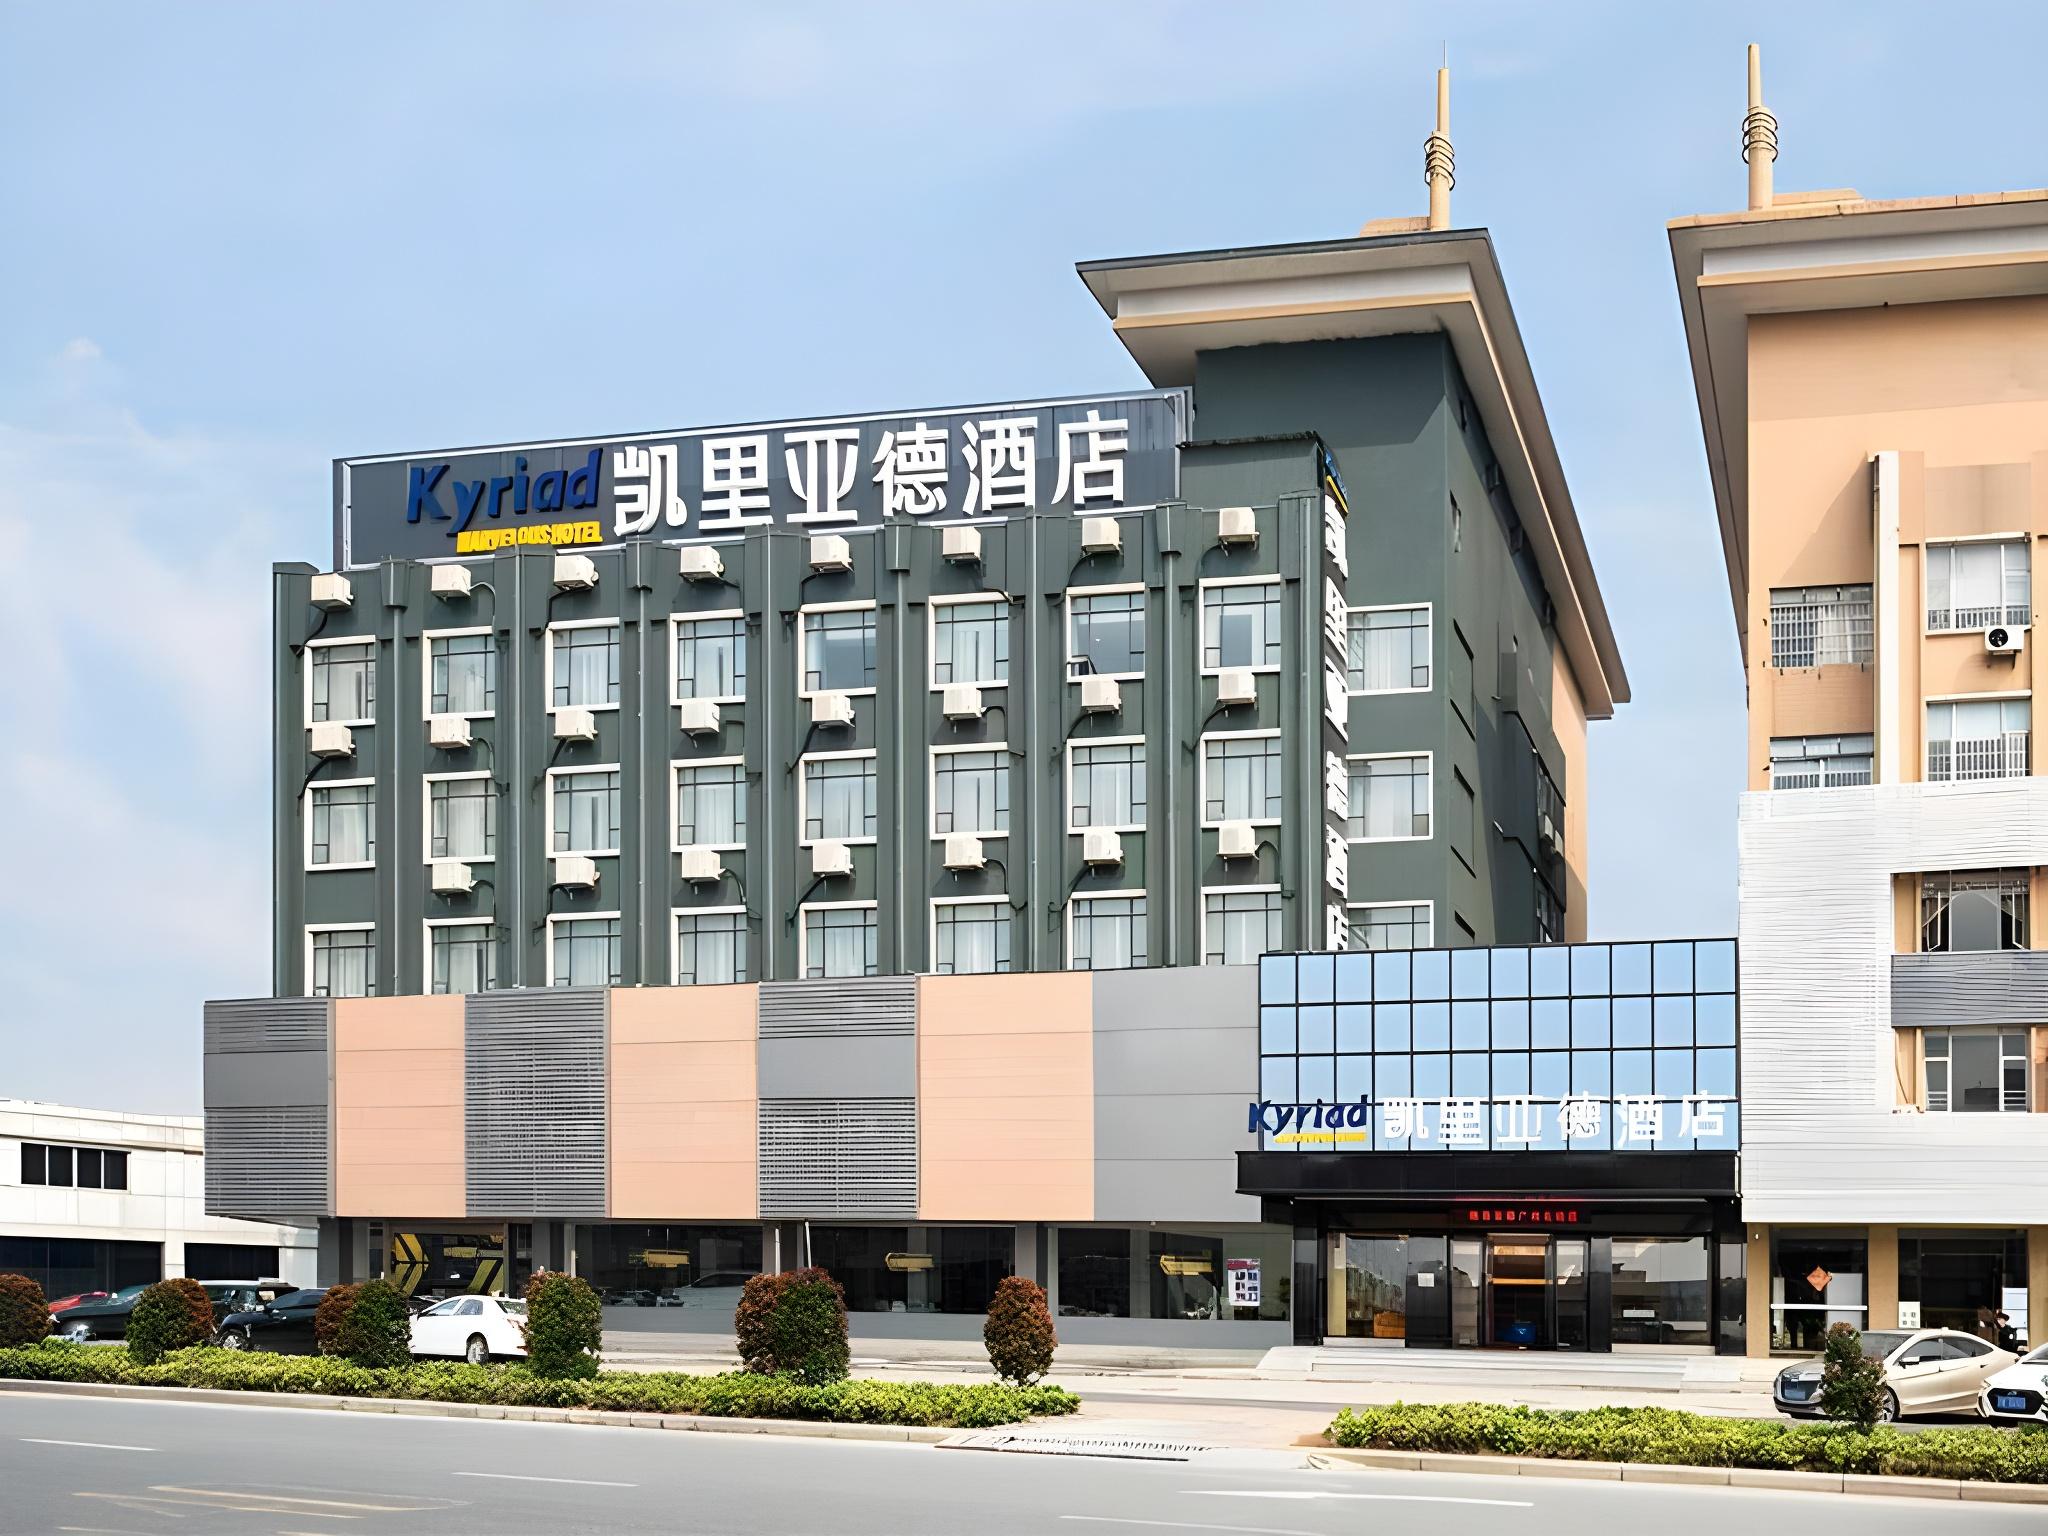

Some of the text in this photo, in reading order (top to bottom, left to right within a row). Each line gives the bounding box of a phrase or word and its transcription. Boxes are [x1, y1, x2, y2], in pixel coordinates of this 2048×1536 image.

[407, 447, 603, 538] Kyriad
[613, 409, 1129, 536] 凯里亚德酒店
[1248, 1094, 1369, 1137] Kyriad
[1382, 1090, 1730, 1149] 凯里亚德酒店
